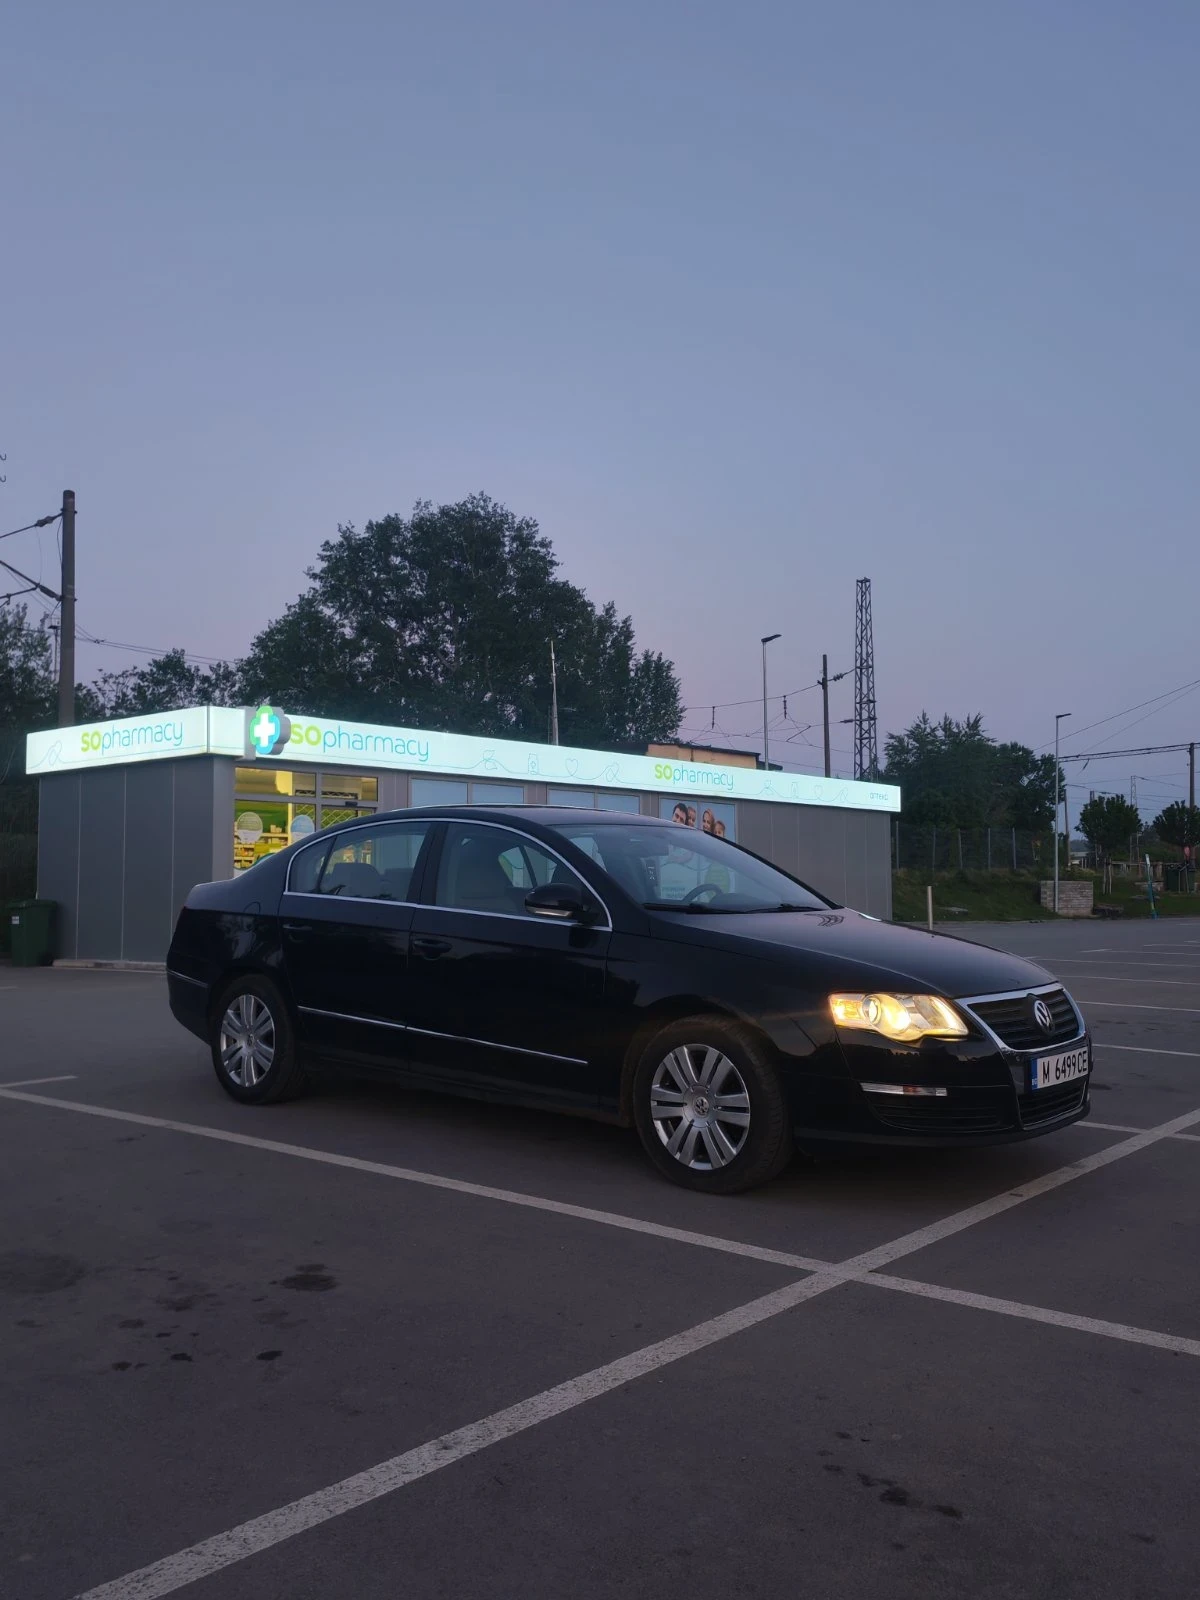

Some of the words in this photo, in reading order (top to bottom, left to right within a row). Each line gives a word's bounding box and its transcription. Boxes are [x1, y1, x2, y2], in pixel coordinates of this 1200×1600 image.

[80, 721, 183, 755] sopharmacy
[290, 722, 429, 762] sopharmacy
[654, 763, 735, 791] sopharmacy
[1042, 1060, 1050, 1084] M
